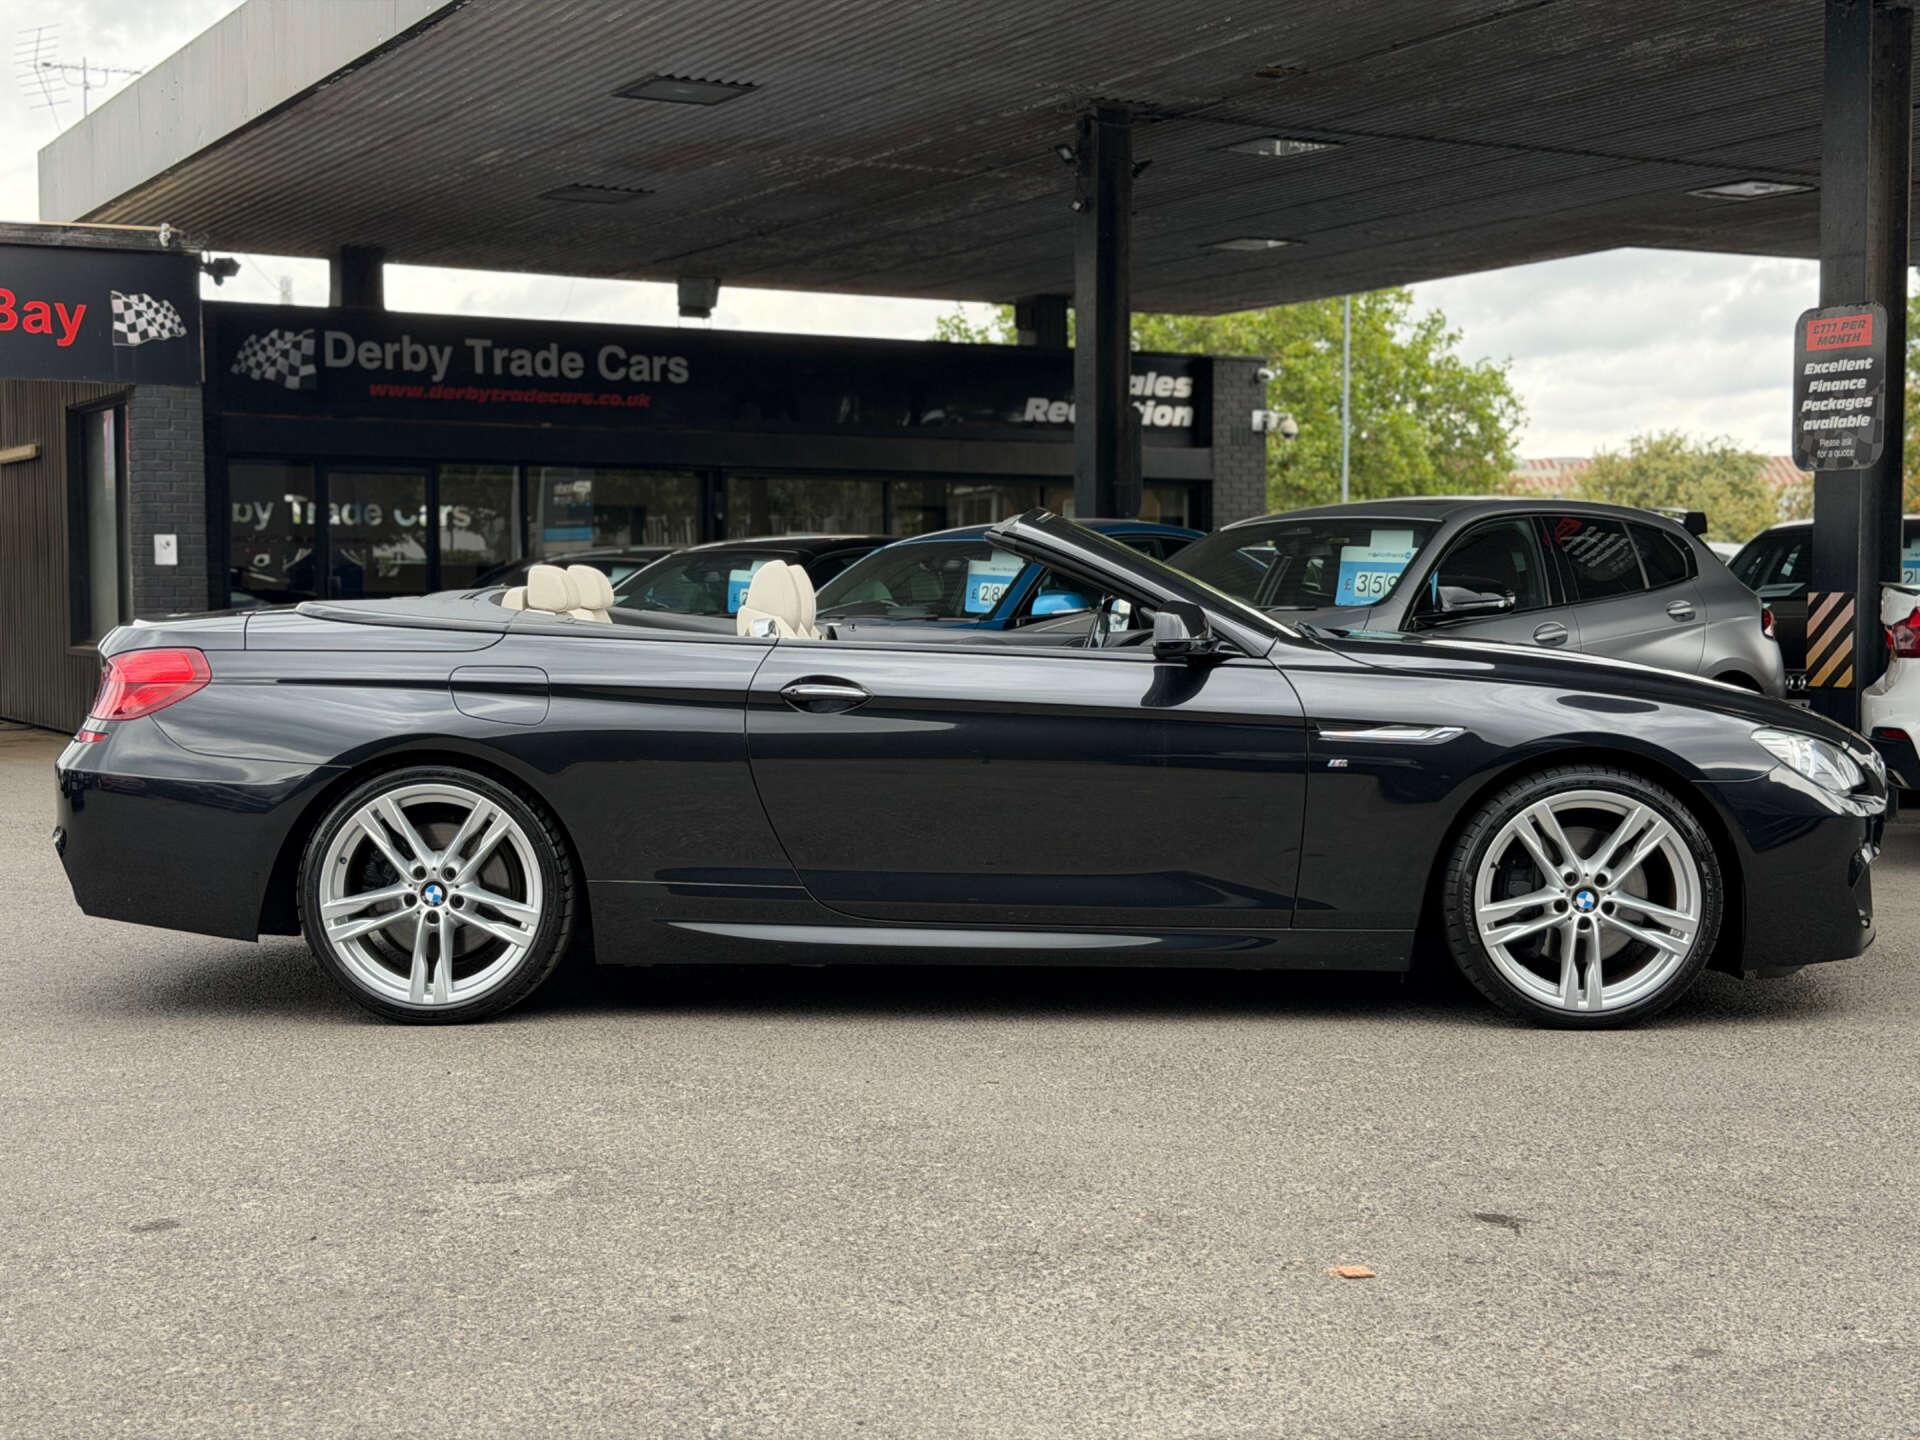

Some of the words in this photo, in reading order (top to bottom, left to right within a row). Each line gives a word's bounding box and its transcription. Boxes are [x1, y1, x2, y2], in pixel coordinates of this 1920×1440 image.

[0, 287, 87, 347] Bay
[1841, 319, 1866, 332] PER
[1816, 331, 1861, 346] MONTH
[323, 329, 454, 383] Derby
[464, 337, 585, 380] Trade
[597, 344, 690, 384] Cars
[1803, 356, 1874, 376] Excellent
[1129, 370, 1194, 398] ales
[1808, 377, 1867, 394] Finance
[368, 383, 652, 409] www.derbytradecars.co.uk
[1801, 396, 1873, 413] Packages
[1803, 413, 1871, 432] available
[1819, 438, 1840, 448] Please
[1816, 449, 1827, 459] for
[1833, 448, 1855, 459] quote
